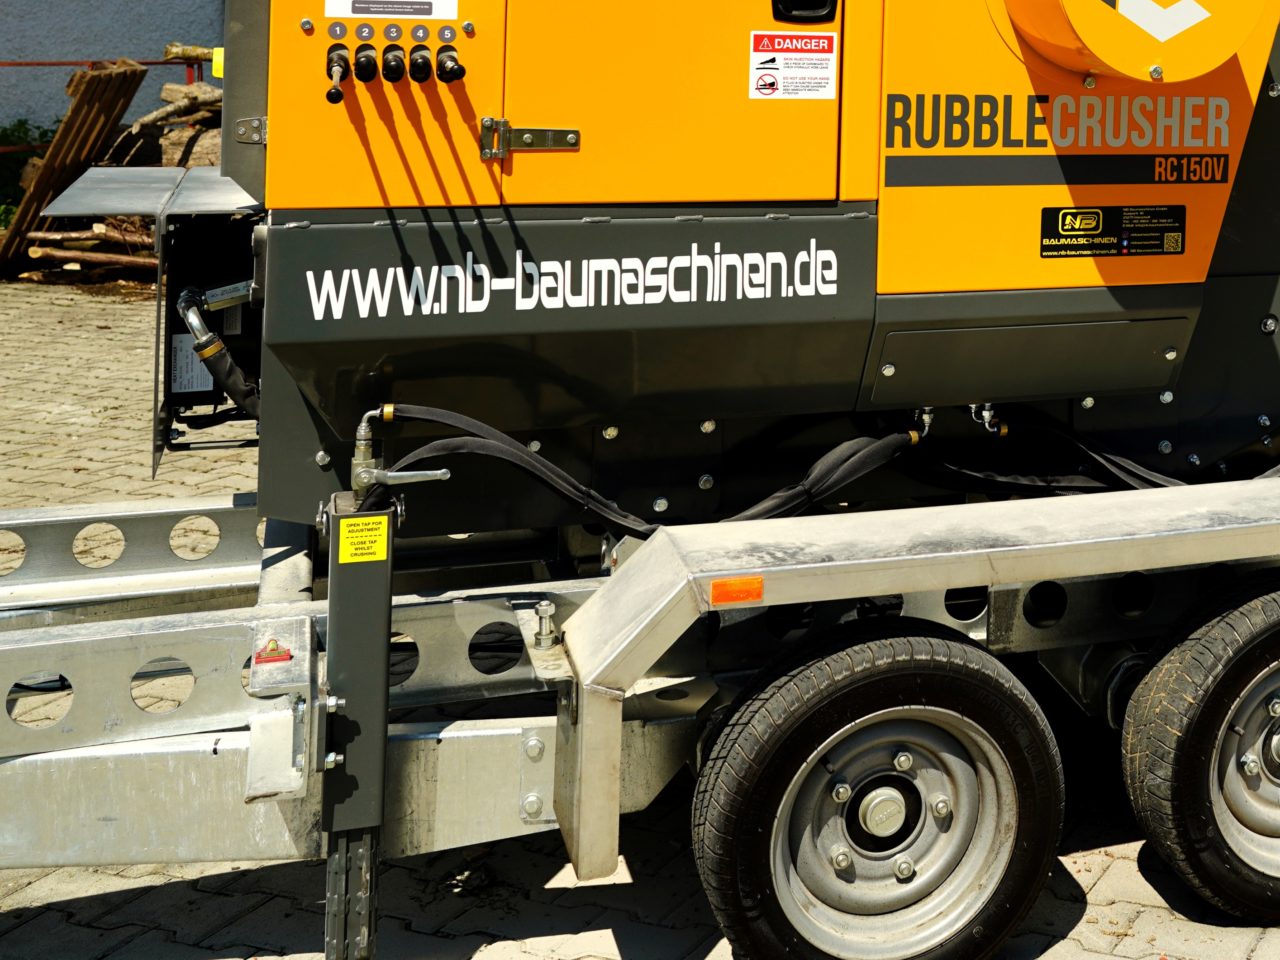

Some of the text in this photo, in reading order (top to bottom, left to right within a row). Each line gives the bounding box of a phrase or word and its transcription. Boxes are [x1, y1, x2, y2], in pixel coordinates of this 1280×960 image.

[362, 28, 369, 36] 2
[390, 28, 397, 37] 3
[444, 30, 451, 38] 5
[774, 38, 829, 49] DANGER
[1154, 157, 1225, 181] RC150V
[1042, 237, 1118, 245] BAUMASCHINEN
[305, 238, 838, 321] www.nb-baumaschinen.de
